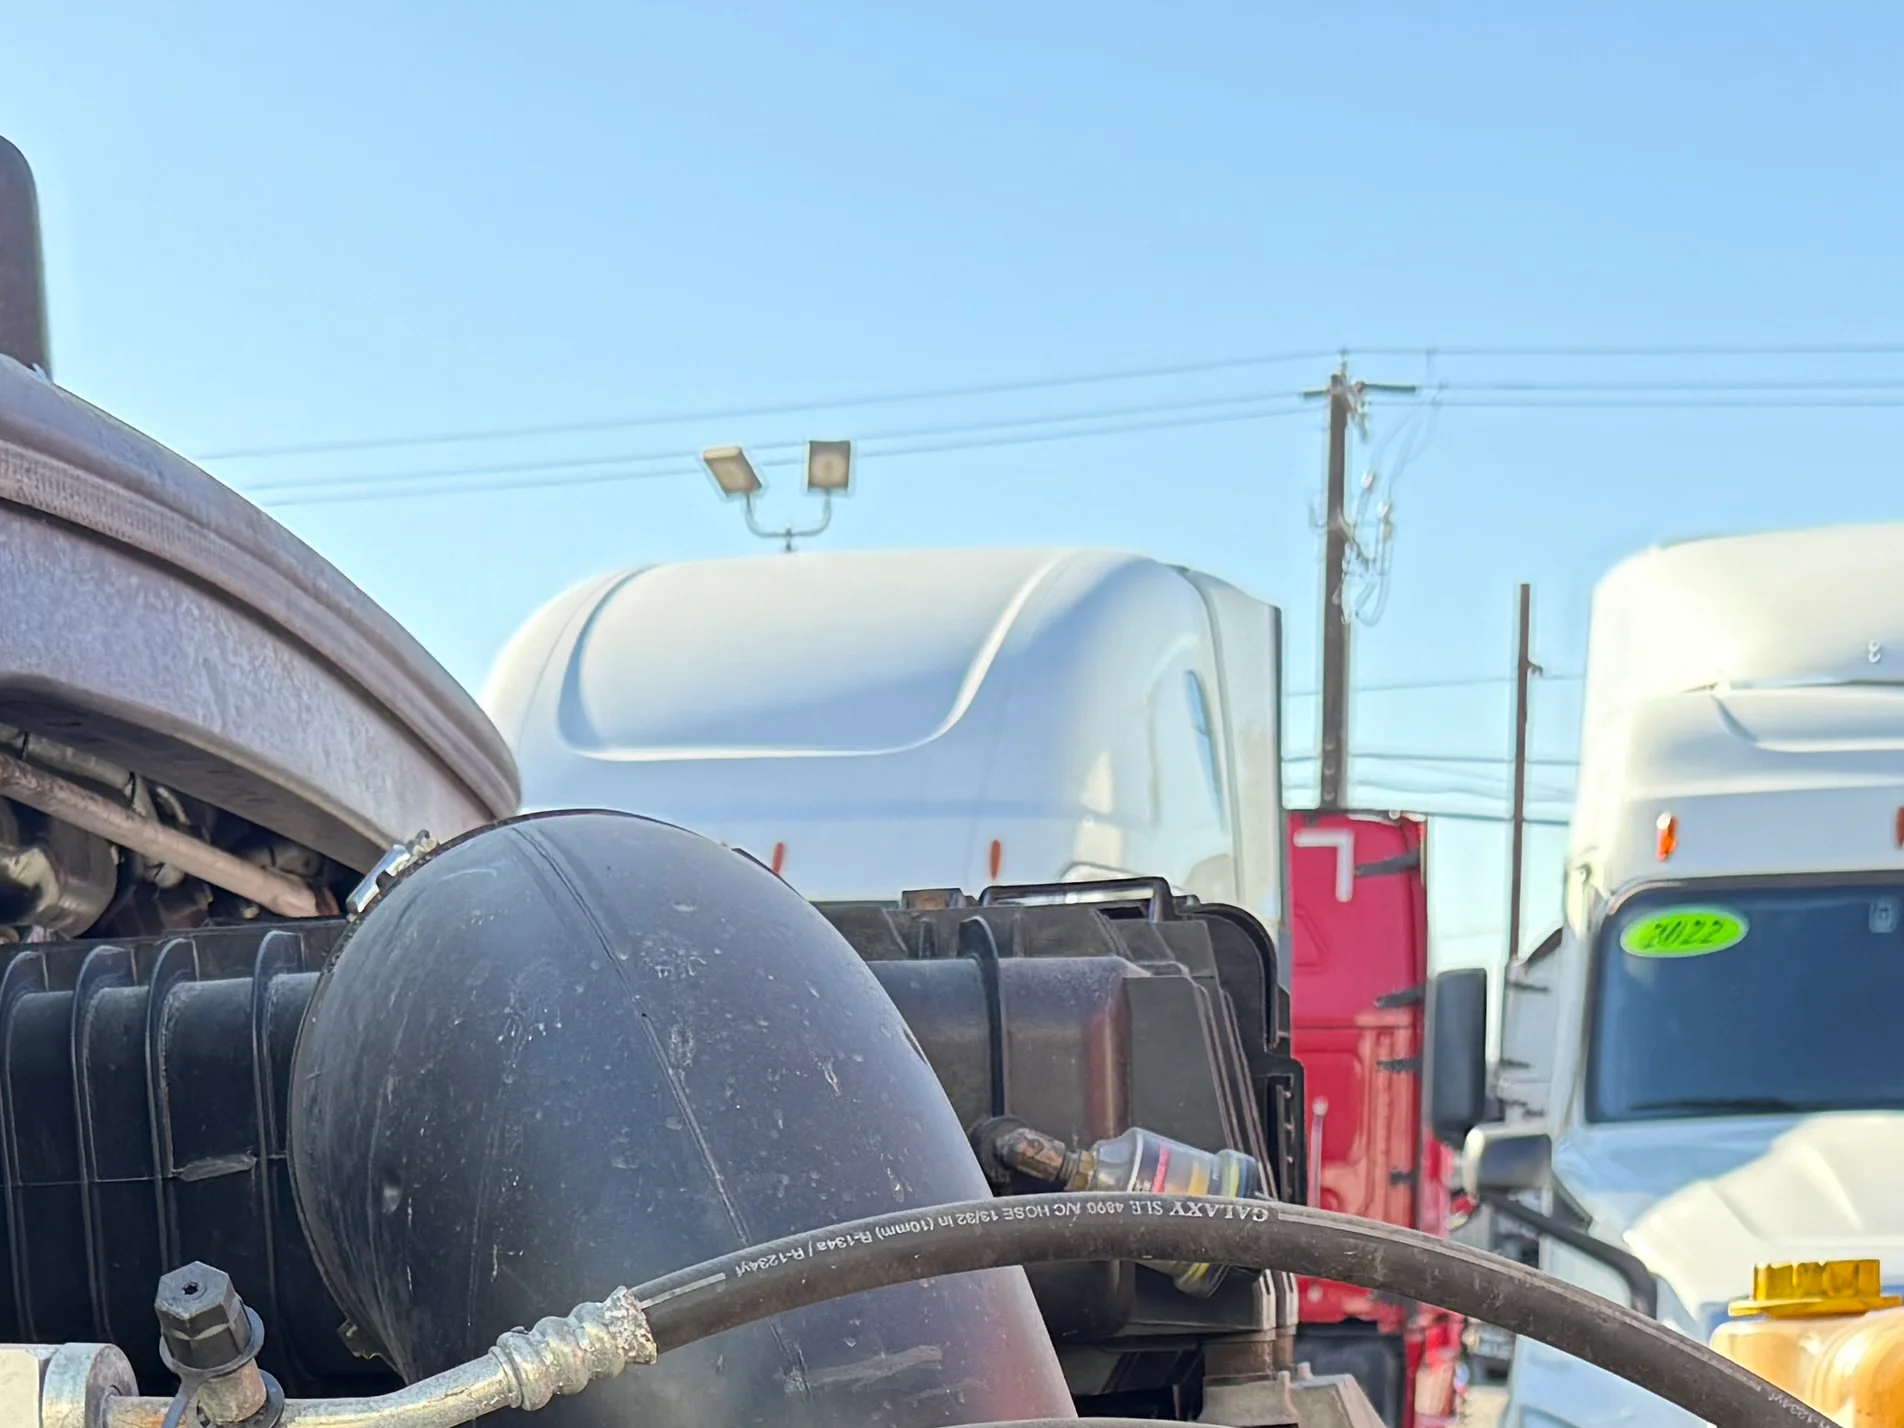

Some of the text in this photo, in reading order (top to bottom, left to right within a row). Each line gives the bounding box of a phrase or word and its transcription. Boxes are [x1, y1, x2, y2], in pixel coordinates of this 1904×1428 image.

[958, 1208, 1000, 1226] 13/32
[1002, 1204, 1050, 1220] HOSE
[1054, 1202, 1081, 1216] A/C
[1087, 1202, 1123, 1215] 4890
[1132, 1201, 1162, 1216] SLE
[1169, 1200, 1269, 1222] GALAXY
[875, 1220, 934, 1240] (10mm)
[816, 1231, 873, 1252] R-134a
[735, 1247, 805, 1278] R-1234yf
